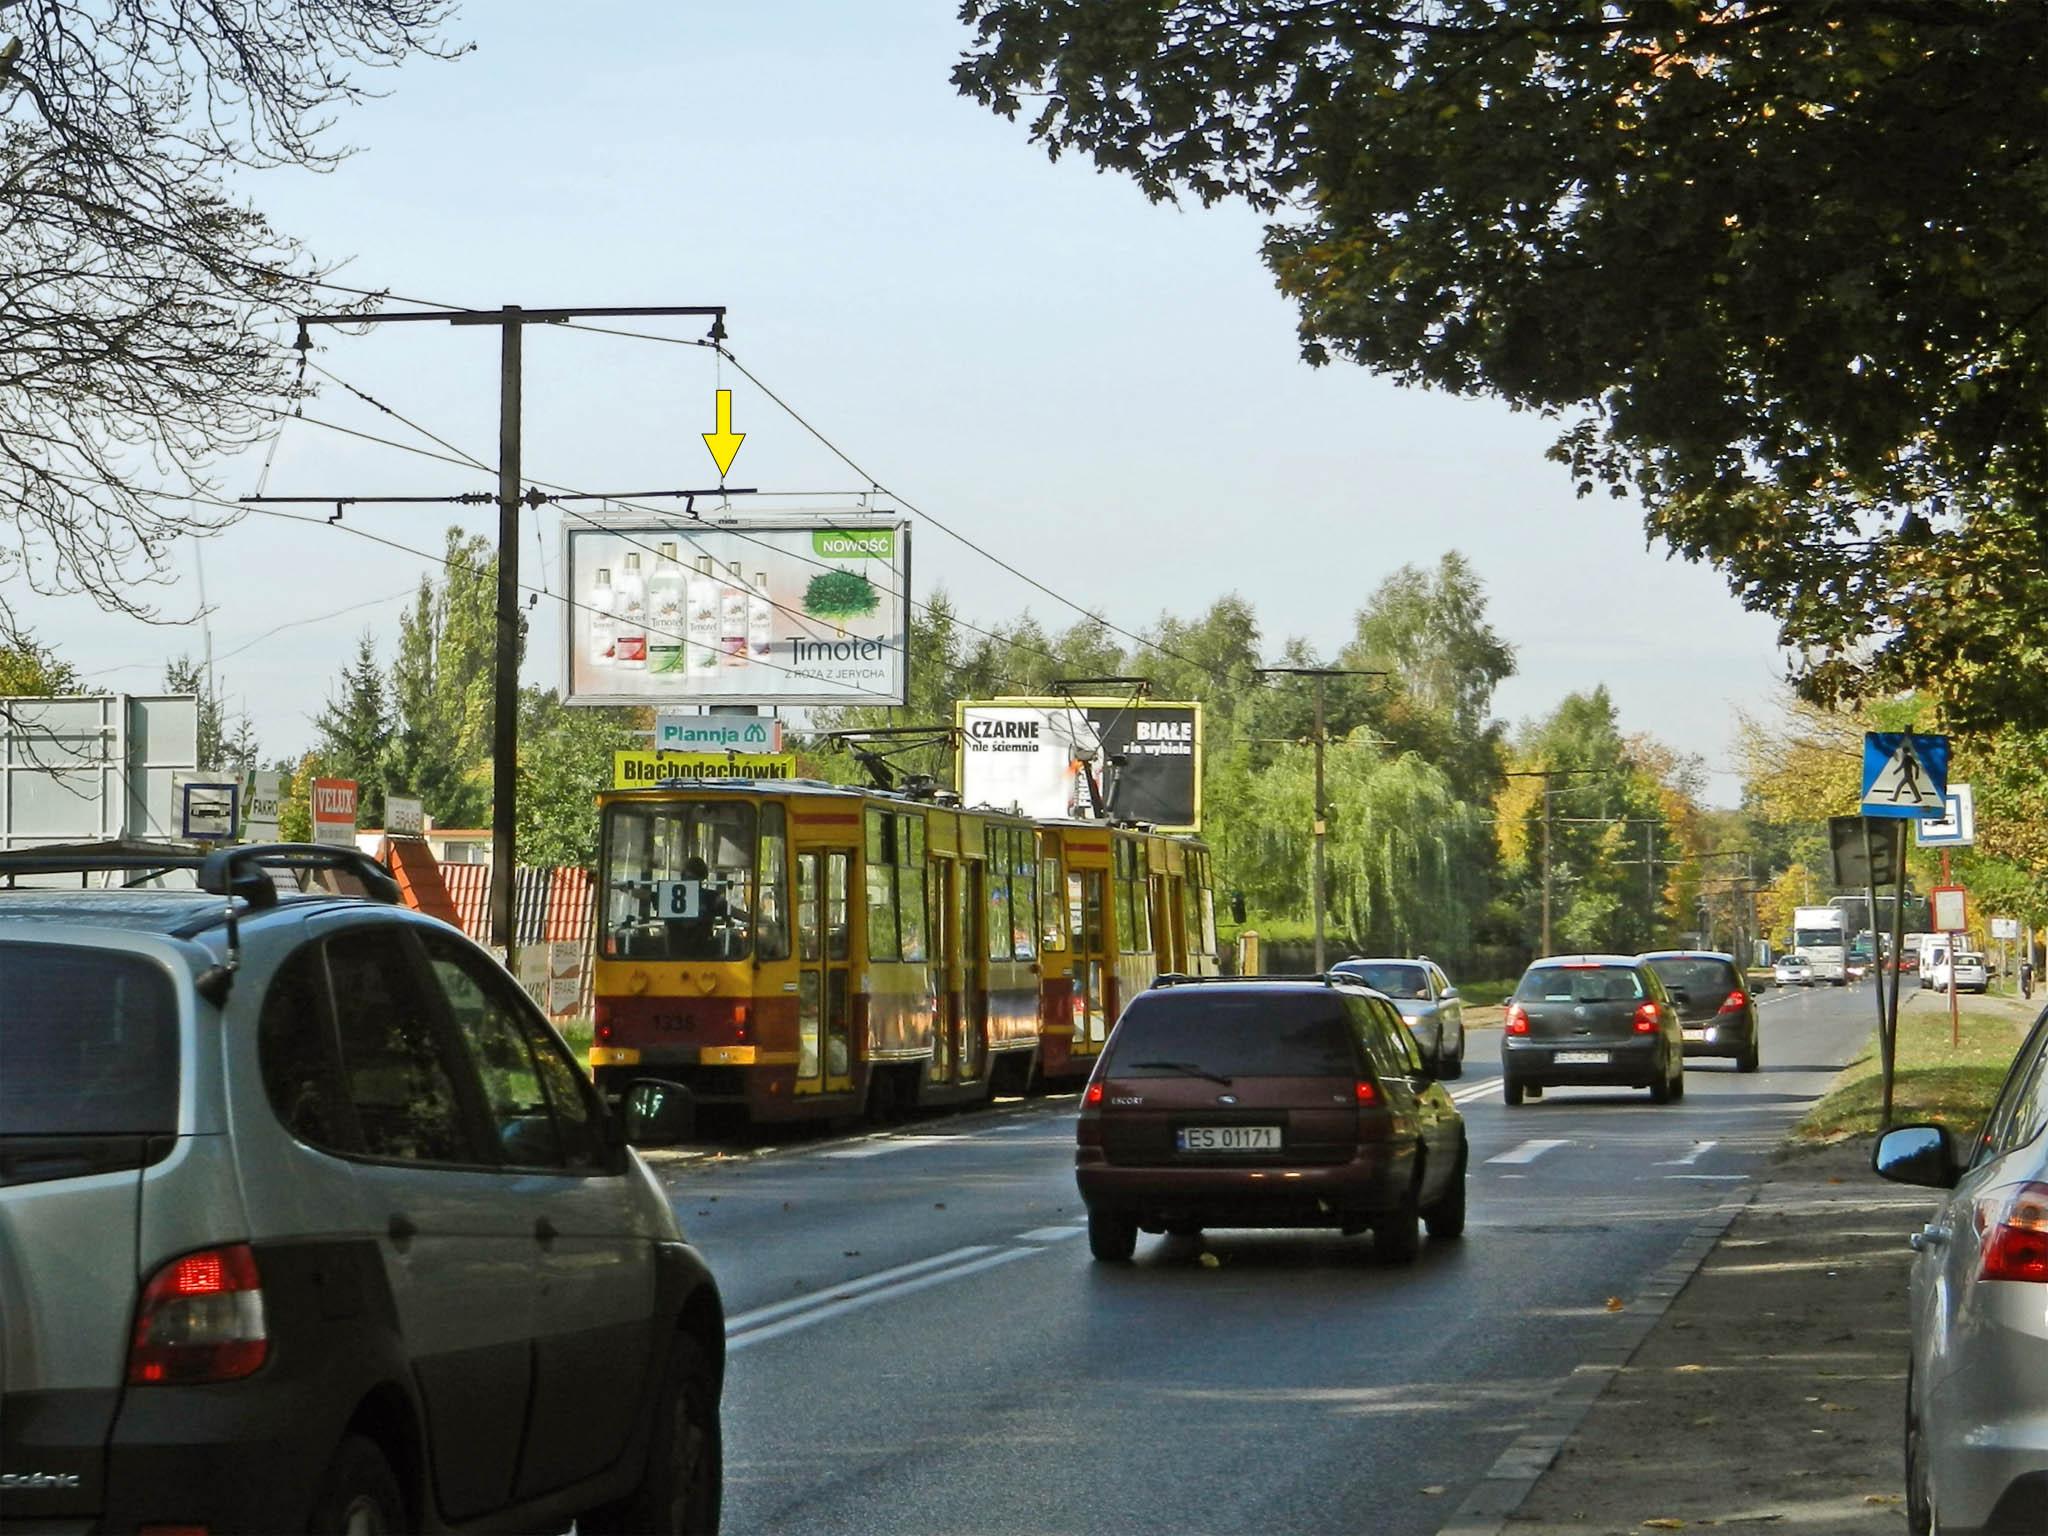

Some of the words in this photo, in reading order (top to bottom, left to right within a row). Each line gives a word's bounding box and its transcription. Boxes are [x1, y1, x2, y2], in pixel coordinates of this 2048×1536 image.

[823, 539, 889, 553] NOWOŚĆ
[785, 635, 885, 665] Timotei
[826, 669, 833, 679] Z
[835, 669, 885, 679] JERYCHA
[664, 725, 740, 745] Plannja
[972, 721, 1039, 739] CZARNE
[1137, 721, 1192, 741] BIAŁE
[972, 742, 989, 753] nie
[992, 740, 1039, 753] ściemnia
[1144, 741, 1191, 756] wybiela
[624, 759, 788, 780] Blachodachówki
[253, 798, 279, 817] FAKRO
[317, 787, 353, 814] VELUX
[671, 884, 687, 914] 8
[1111, 1096, 1144, 1105] ESCORT
[1188, 1129, 1215, 1148] ES
[1222, 1128, 1272, 1147] 01171
